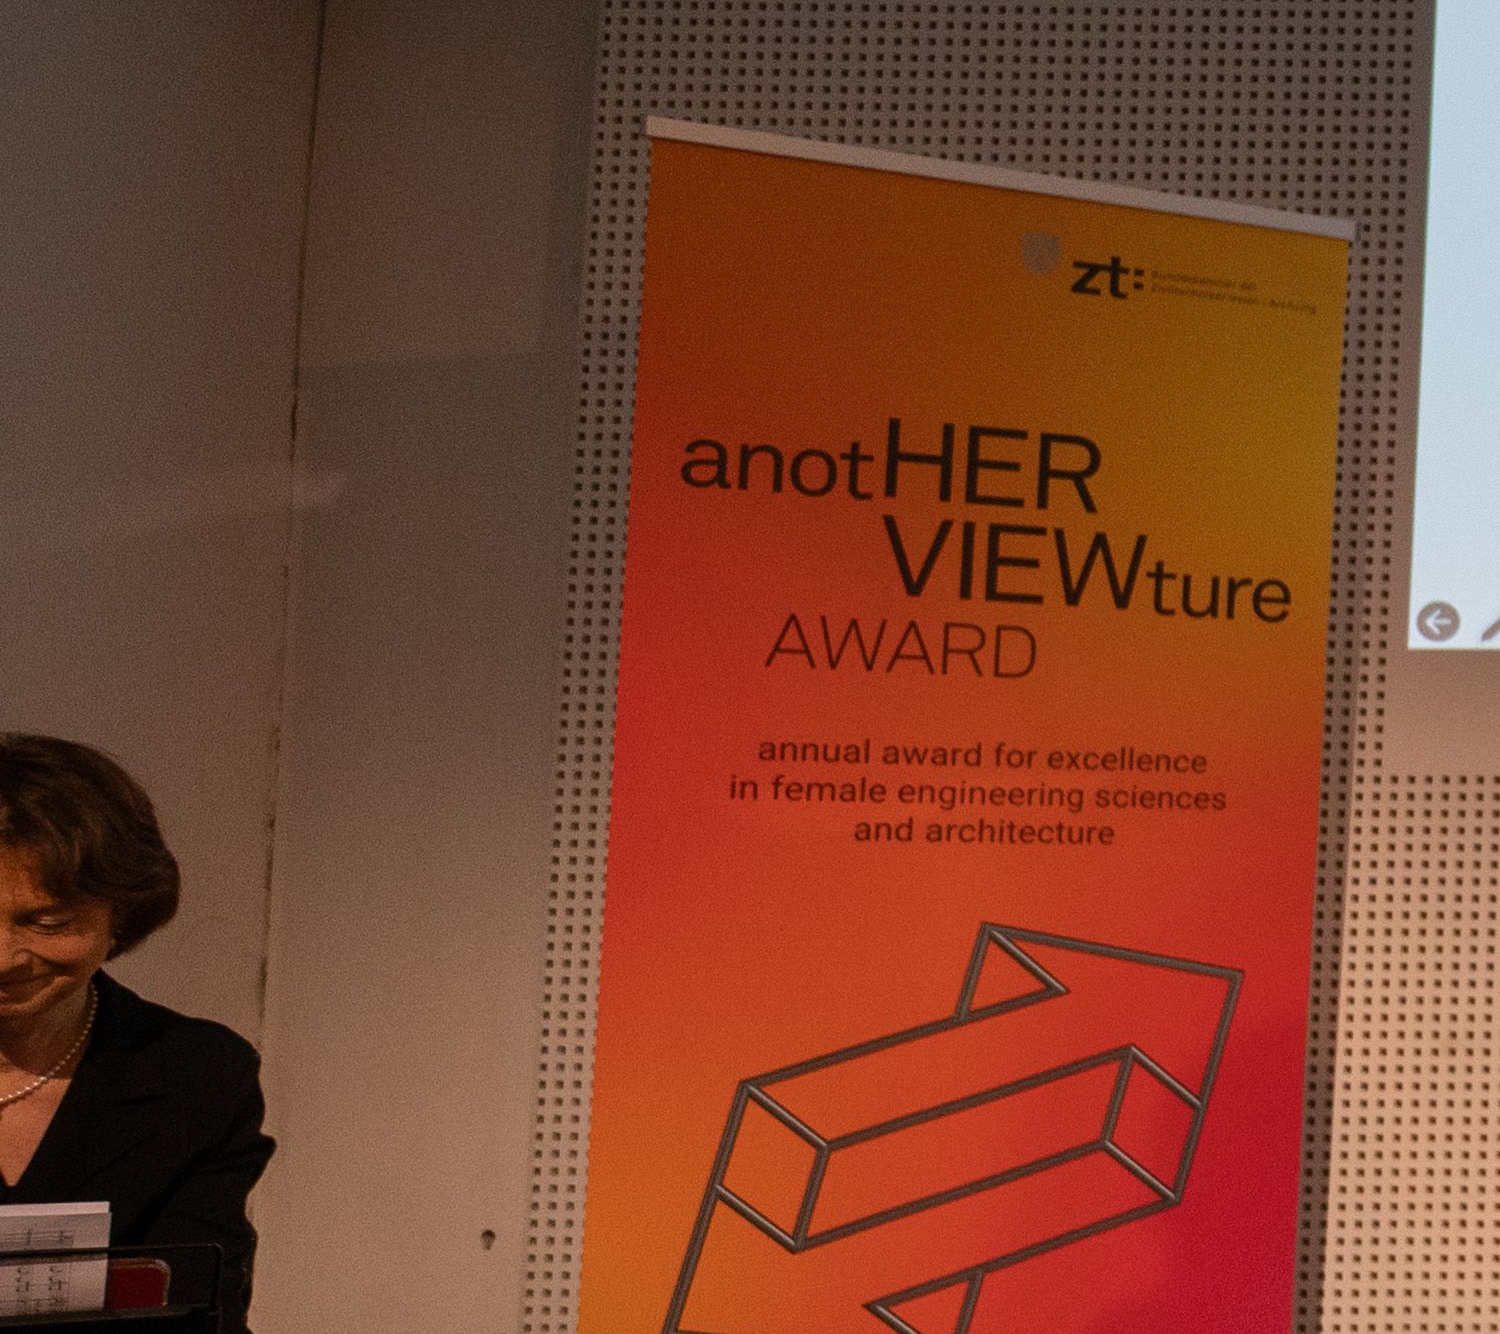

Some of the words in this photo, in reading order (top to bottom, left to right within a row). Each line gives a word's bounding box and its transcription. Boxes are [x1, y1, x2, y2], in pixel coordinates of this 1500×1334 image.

[681, 418, 1100, 514] anotHER
[883, 515, 1292, 622] VIEWture
[765, 613, 1036, 678] AWARD
[757, 738, 871, 765] annual
[882, 742, 982, 767] award
[994, 743, 1038, 769] for
[1047, 747, 1208, 775] excellence
[729, 774, 759, 801] in
[771, 776, 887, 805] female
[897, 781, 1084, 813] engineering
[1095, 784, 1227, 812] sciences
[854, 817, 914, 843] and
[925, 819, 1115, 846] architecture
